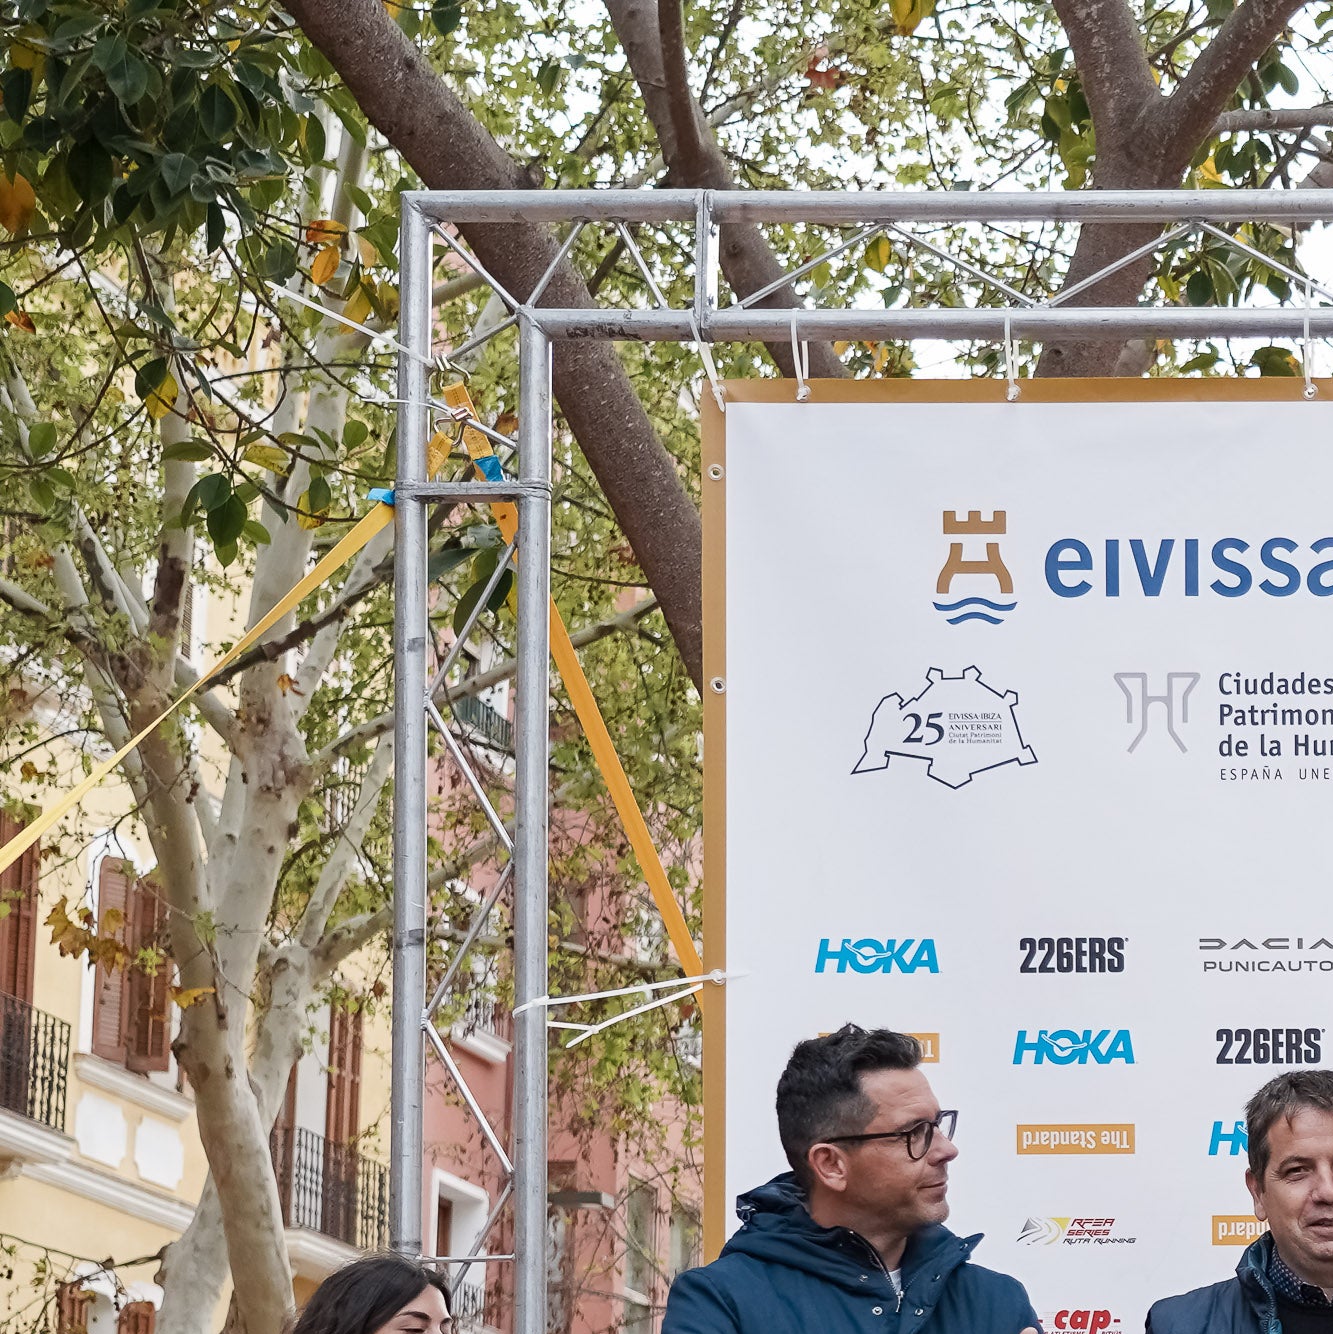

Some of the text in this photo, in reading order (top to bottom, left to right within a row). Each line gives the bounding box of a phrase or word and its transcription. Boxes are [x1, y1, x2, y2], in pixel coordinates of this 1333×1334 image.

[902, 712, 945, 746] 25
[1218, 733, 1249, 757] de
[1260, 733, 1282, 757] la
[1220, 765, 1283, 781] ESPAÑA
[814, 938, 940, 975] HOKA
[1019, 936, 1125, 974] 226ERS
[1203, 960, 1333, 973] PUNICAUTO
[1012, 1029, 1135, 1066] HOKA
[1215, 1027, 1321, 1065] 226ERS
[1022, 1129, 1131, 1149] The Standard
[1066, 1229, 1111, 1238] SERIES
[1070, 1218, 1116, 1230] RFEA
[1217, 1221, 1270, 1240] ndard
[1062, 1237, 1137, 1247] RUTA RUNNING
